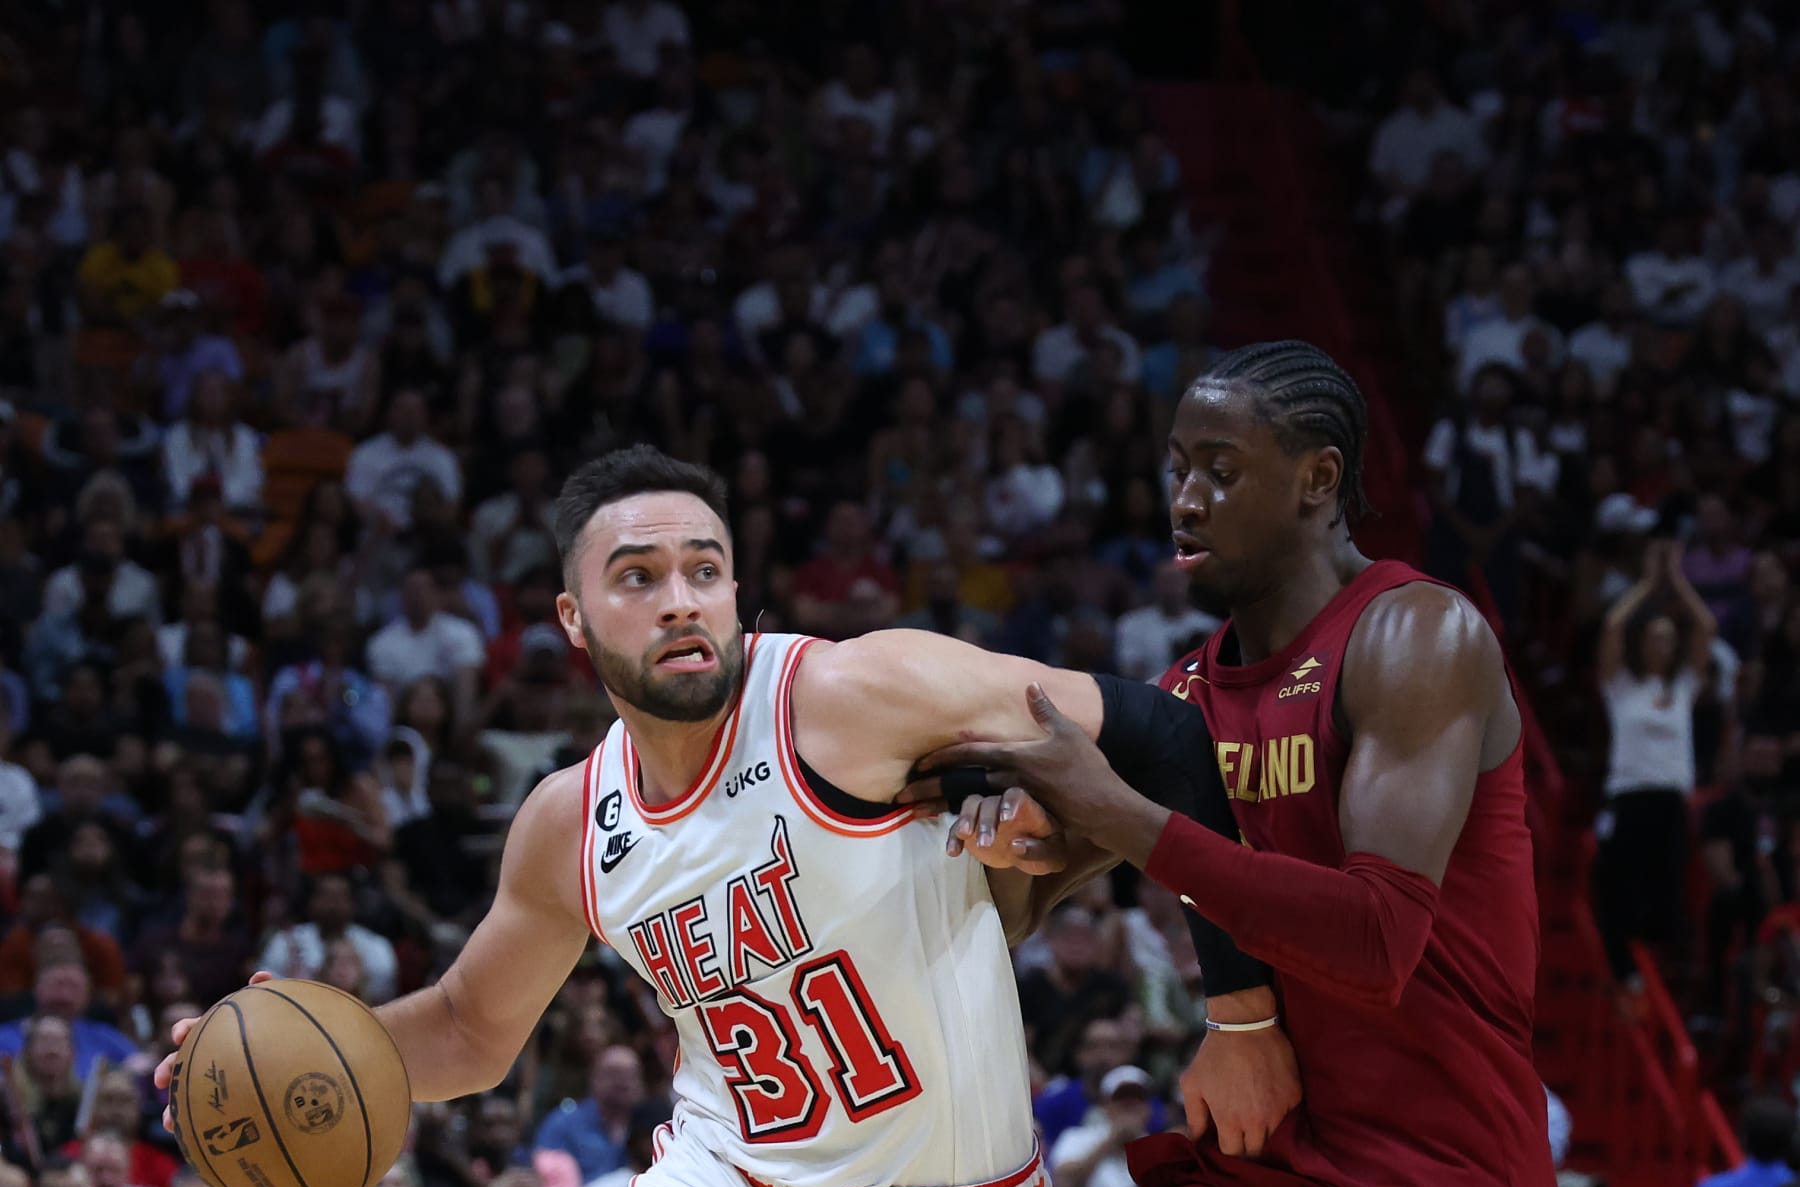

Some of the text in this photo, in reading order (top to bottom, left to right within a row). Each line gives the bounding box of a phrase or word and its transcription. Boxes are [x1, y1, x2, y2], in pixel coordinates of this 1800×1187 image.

[1278, 681, 1321, 699] CLIFFS
[605, 830, 632, 858] NIKE
[628, 814, 814, 1010] HEAT
[695, 948, 924, 1145] 31
